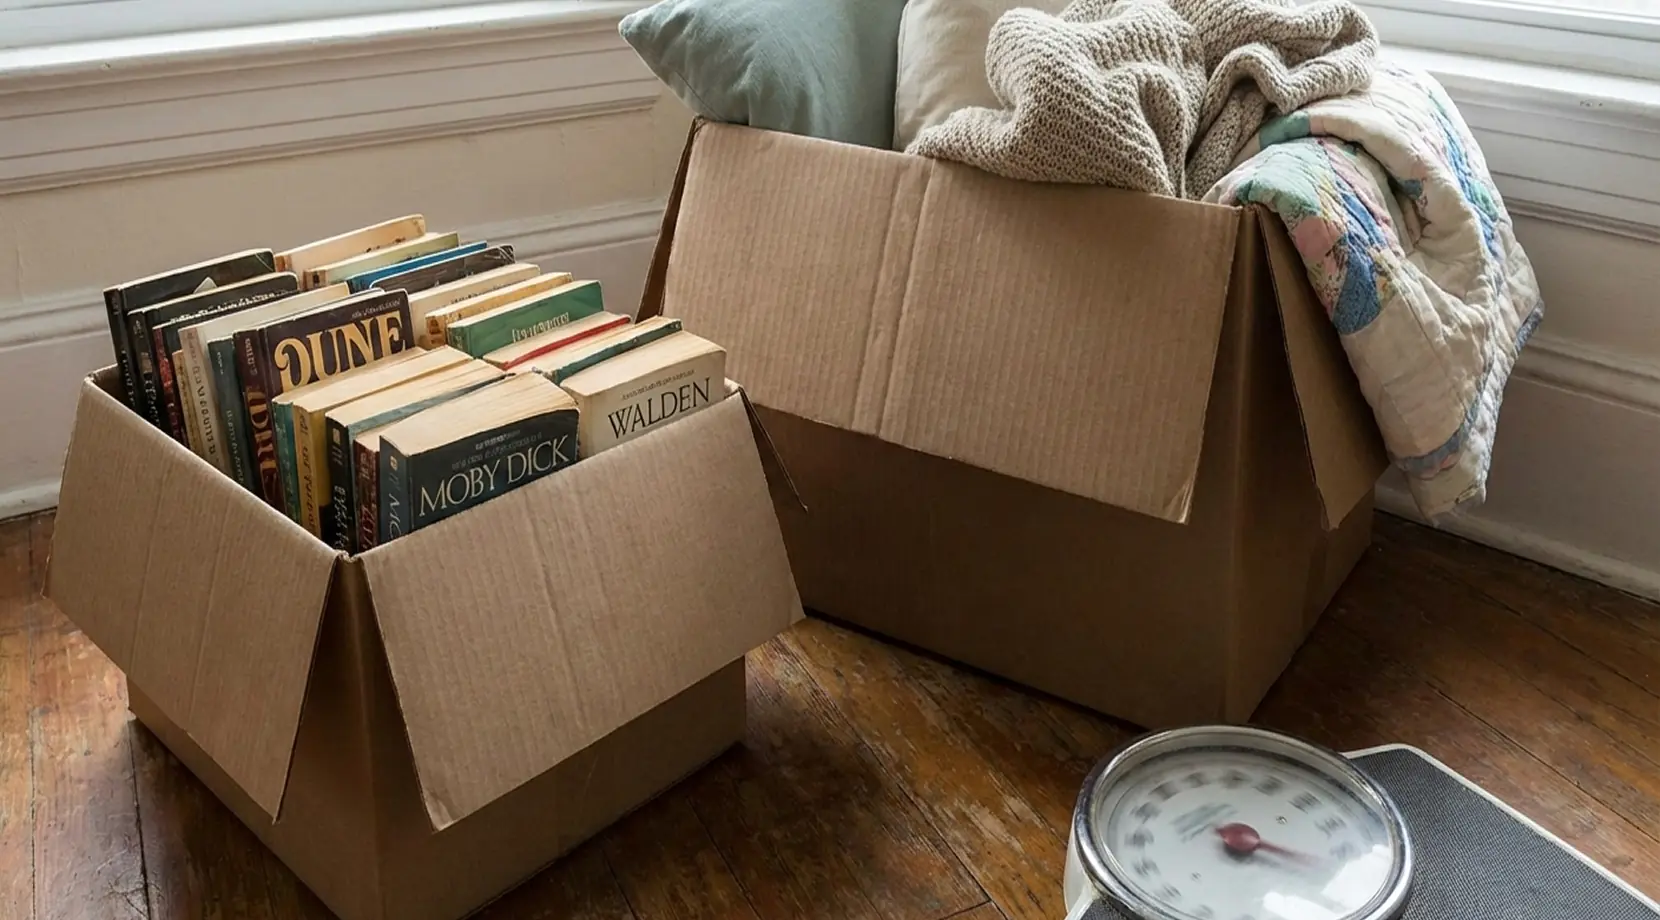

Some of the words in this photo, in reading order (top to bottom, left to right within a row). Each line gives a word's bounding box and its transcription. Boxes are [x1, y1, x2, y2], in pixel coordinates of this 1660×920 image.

[274, 310, 406, 393] DUNE
[607, 377, 711, 439] WALDEN
[419, 459, 501, 517] MOBY
[507, 434, 570, 484] DICK
